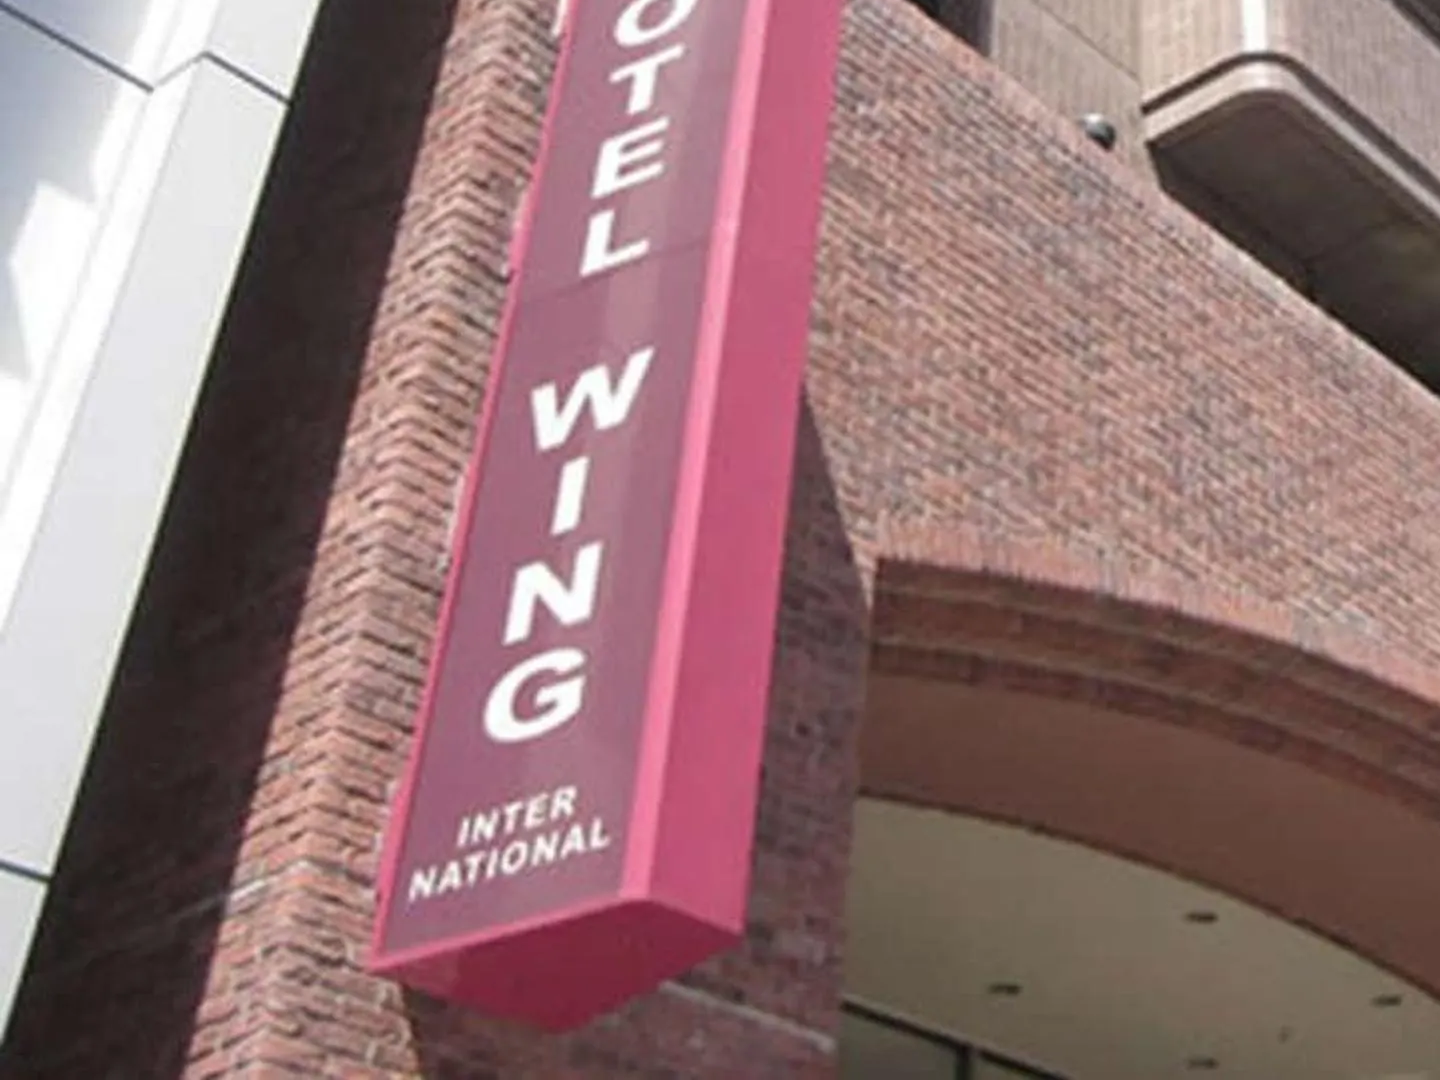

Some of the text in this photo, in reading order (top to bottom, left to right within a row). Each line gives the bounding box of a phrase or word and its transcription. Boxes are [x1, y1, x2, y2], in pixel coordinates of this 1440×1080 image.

[482, 345, 656, 744] WING
[456, 784, 579, 848] INTER
[406, 817, 611, 904] NATIONAL
